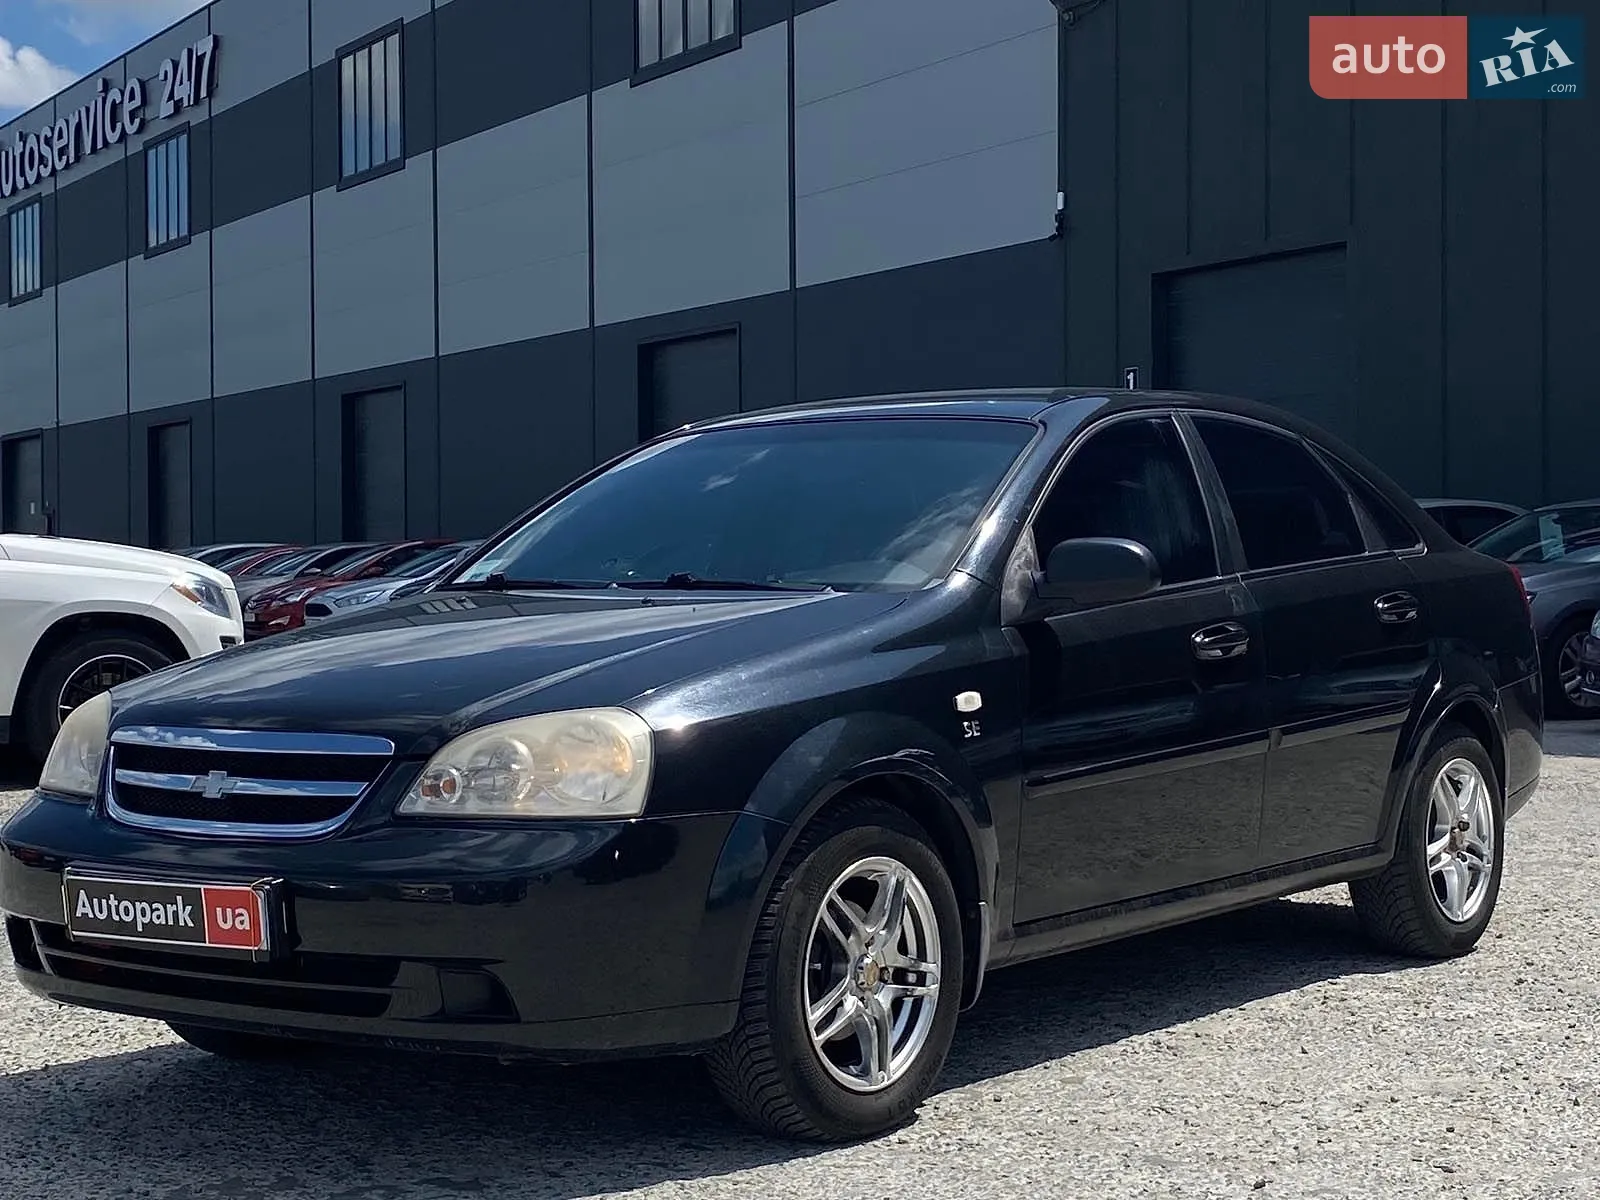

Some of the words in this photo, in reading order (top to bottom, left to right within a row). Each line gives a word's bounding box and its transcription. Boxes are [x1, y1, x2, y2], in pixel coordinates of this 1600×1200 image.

[0, 77, 142, 199] utoservice
[158, 34, 217, 119] 24/7
[1127, 372, 1134, 390] 1
[962, 720, 981, 738] SE
[75, 889, 195, 932] Autopark
[215, 906, 251, 930] ua
